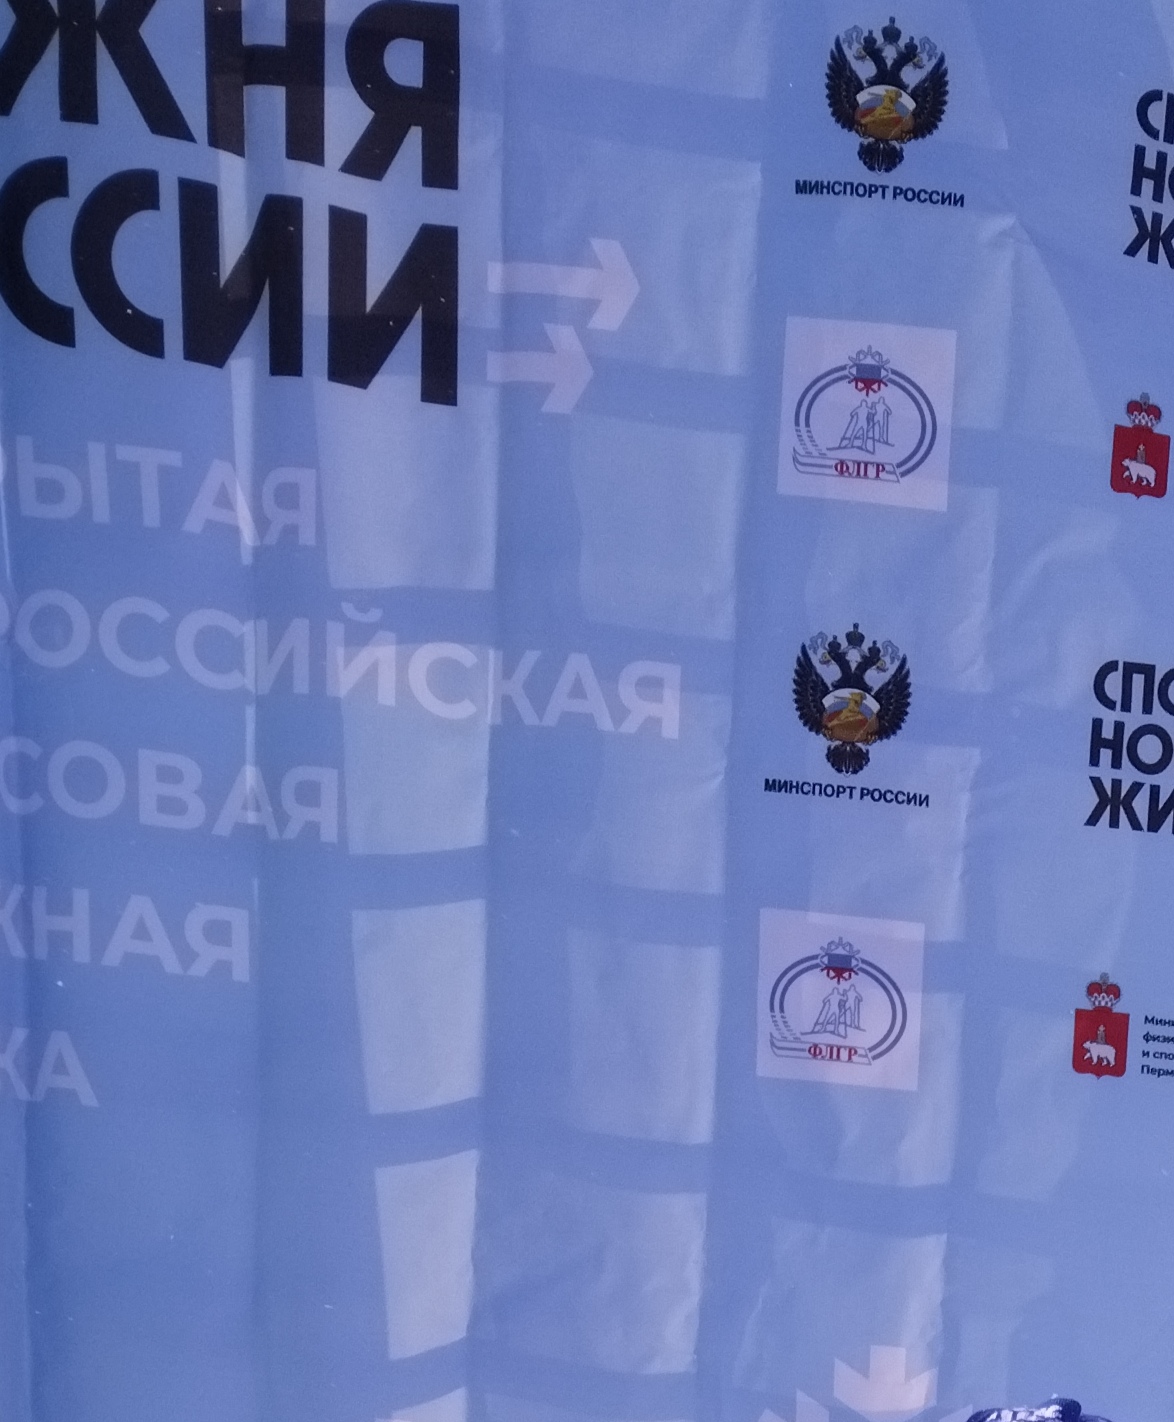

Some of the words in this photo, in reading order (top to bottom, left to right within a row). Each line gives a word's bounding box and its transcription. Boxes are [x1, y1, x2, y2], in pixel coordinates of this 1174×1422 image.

[795, 179, 889, 201] МИНСПОРТ
[893, 185, 965, 208] РОССИИ
[0, 435, 317, 546] ЫТАЯ
[0, 588, 682, 740] ОССИЙСКАЯ
[764, 778, 856, 800] МИНСПОРТ
[859, 785, 930, 808] РОССИИ
[1141, 1050, 1150, 1058] и
